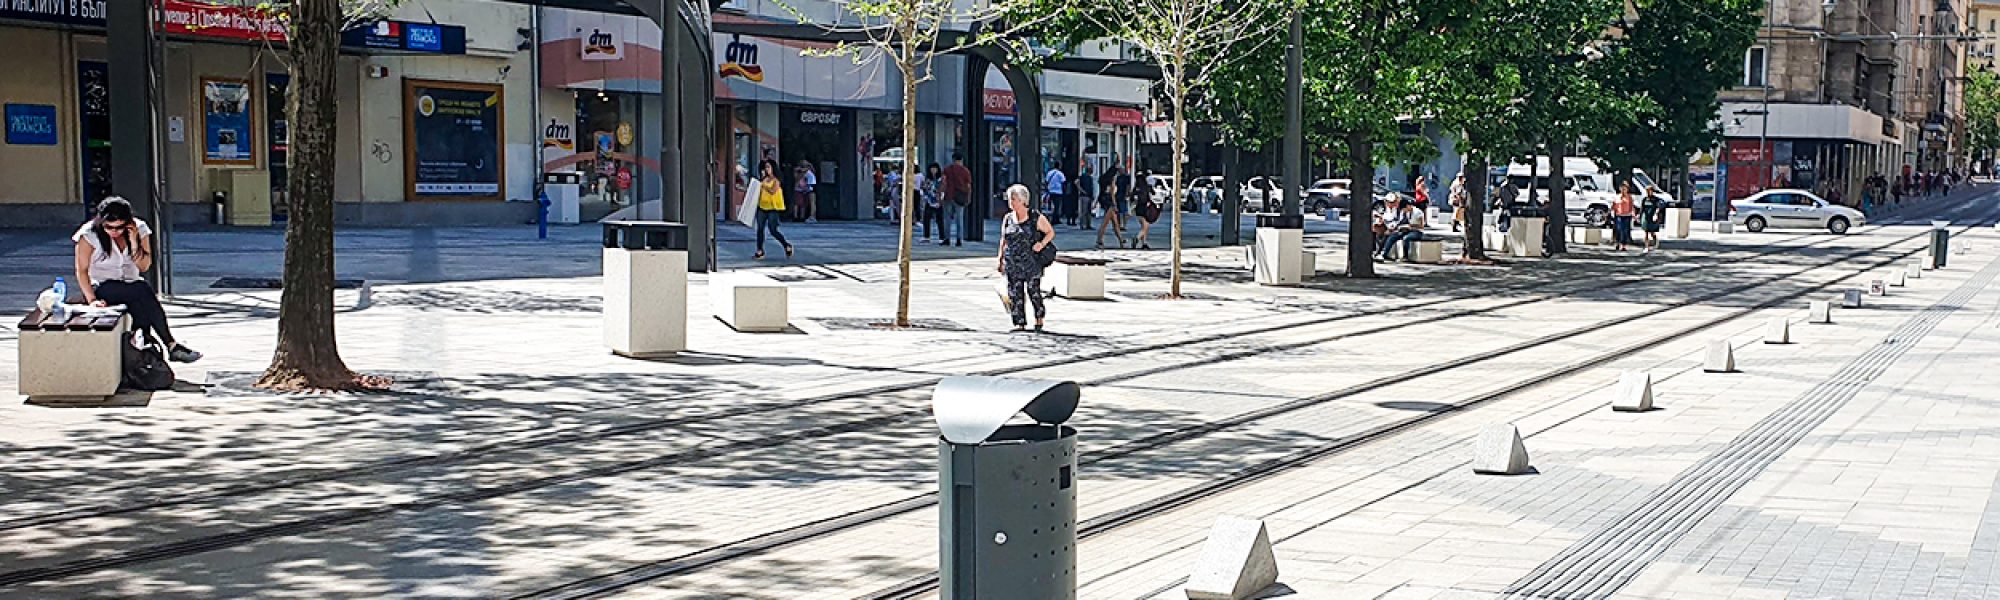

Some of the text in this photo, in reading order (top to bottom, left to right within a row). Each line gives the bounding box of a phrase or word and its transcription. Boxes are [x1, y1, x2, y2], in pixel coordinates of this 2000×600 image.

[81, 0, 107, 19] БЪЛ
[589, 29, 612, 46] dm
[725, 34, 758, 65] dm
[545, 119, 569, 138] dm
